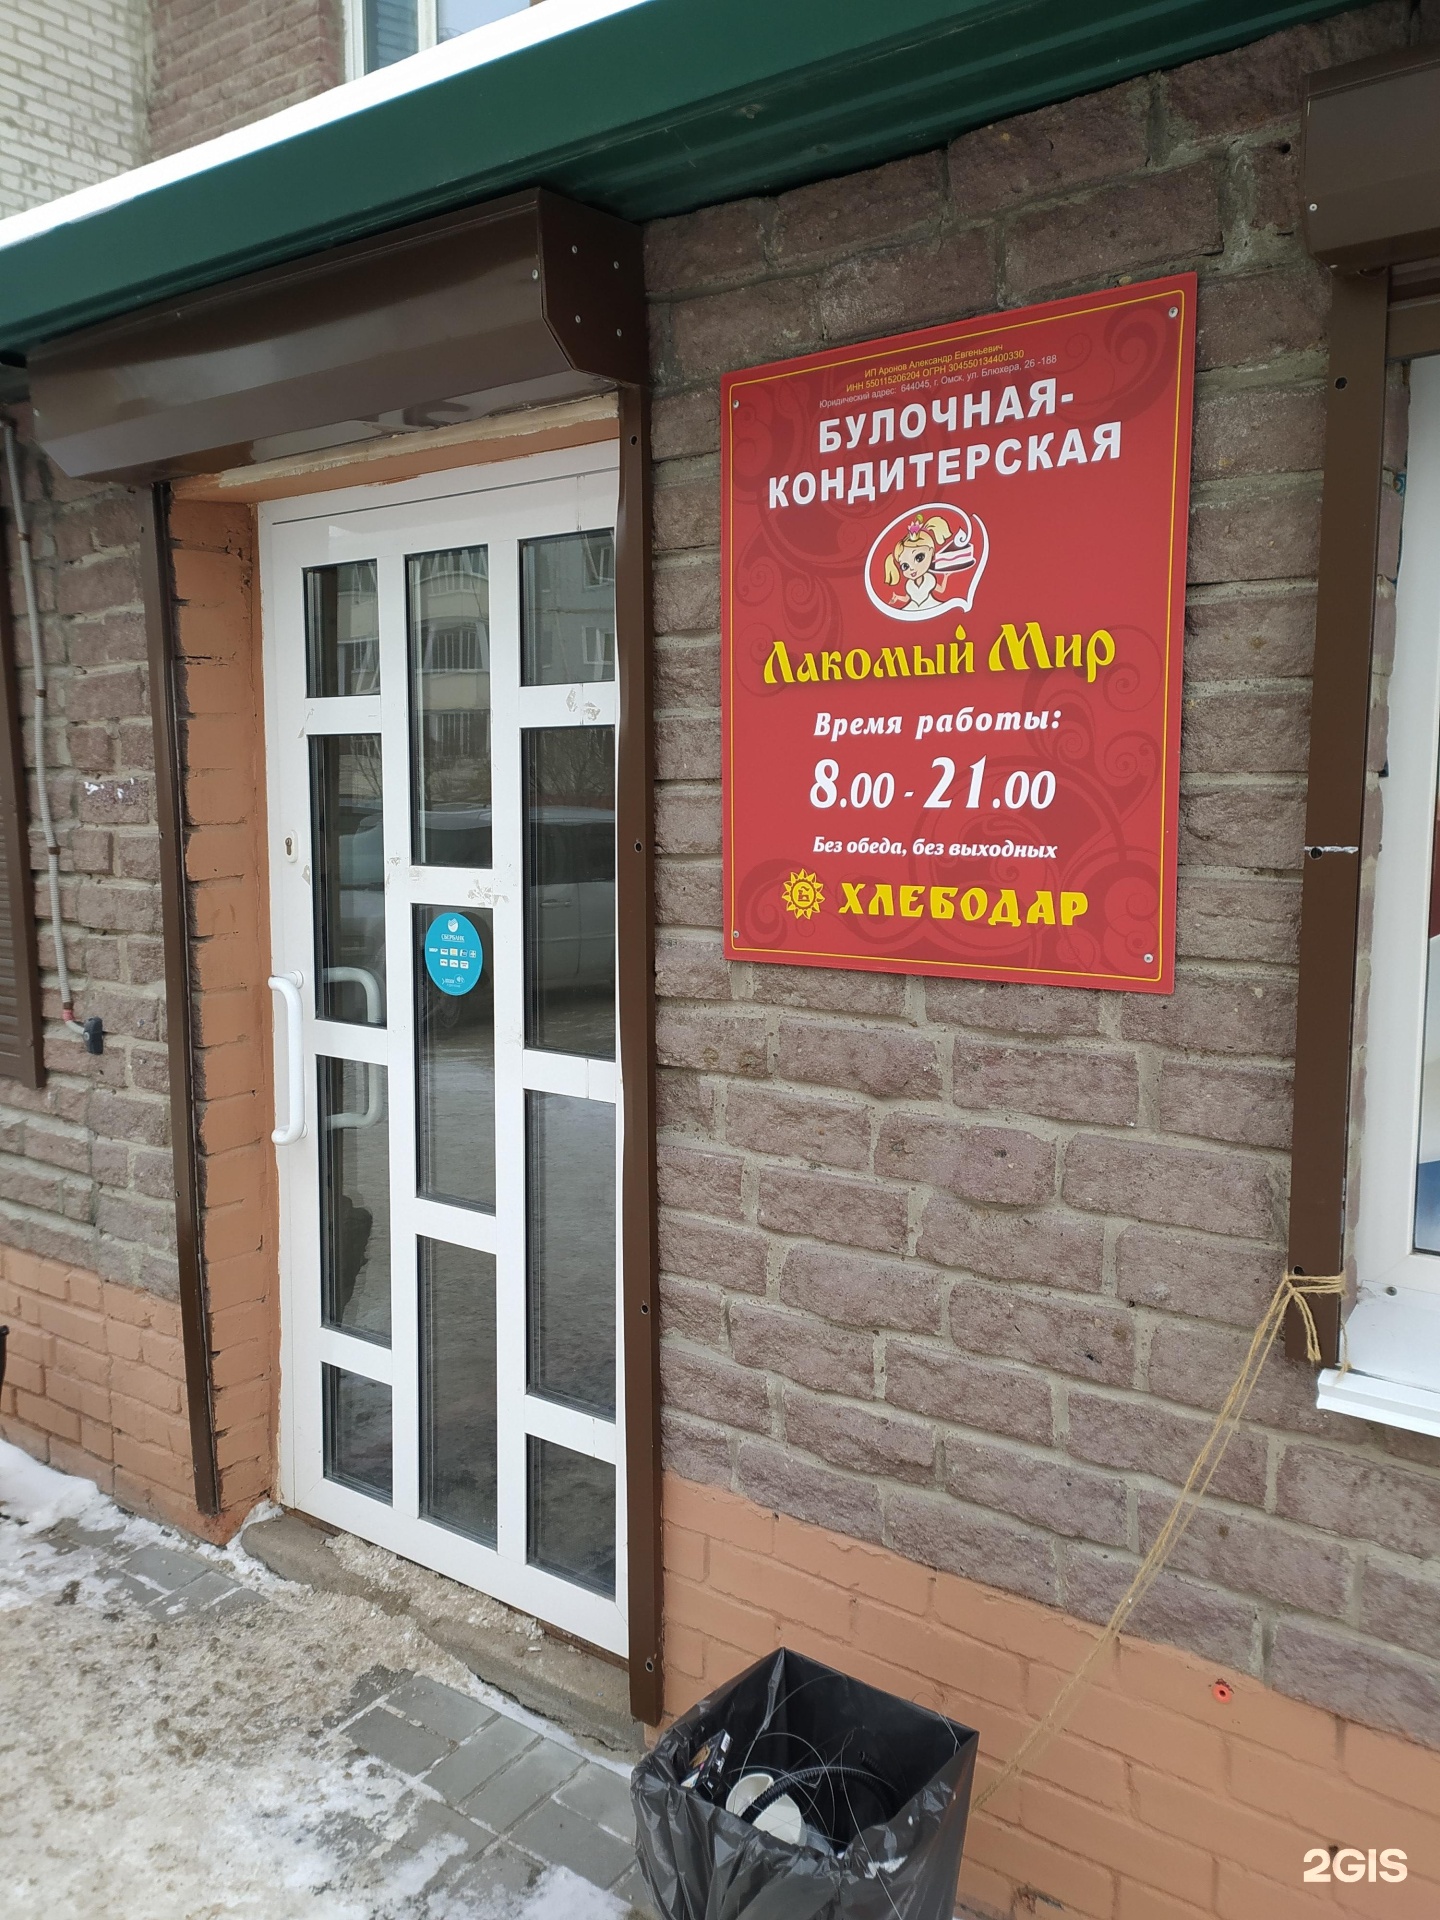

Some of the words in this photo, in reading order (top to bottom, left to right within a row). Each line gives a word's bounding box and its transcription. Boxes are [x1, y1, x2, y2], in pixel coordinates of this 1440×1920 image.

[819, 392, 870, 408] Юридический
[872, 387, 897, 400] адрес:
[941, 374, 965, 385] Омск,
[966, 371, 979, 382] ул.
[981, 363, 1022, 377] Блюхера,
[1024, 359, 1036, 369] 26
[846, 382, 864, 392] ИНН
[922, 365, 946, 376] ОГРН
[865, 368, 877, 378] ИП
[879, 361, 907, 376] Аронов
[909, 354, 953, 371] Александр
[954, 344, 1003, 360] Евгеньевич
[818, 378, 1074, 453] БУЛОЧНАЯ-
[768, 422, 1122, 509] КОНДИТЕРСКАЯ
[763, 624, 975, 684] Лакомый
[988, 621, 1116, 683] Мир
[813, 711, 902, 742] Время
[915, 707, 1062, 740] работы:
[809, 758, 896, 809] 8.00
[923, 755, 1057, 809] 21.00
[812, 836, 843, 853] Без
[846, 837, 907, 857] обеда,
[912, 839, 945, 857] без
[948, 842, 1058, 859] выходных
[838, 882, 1089, 927] ХЛЕБОДАР
